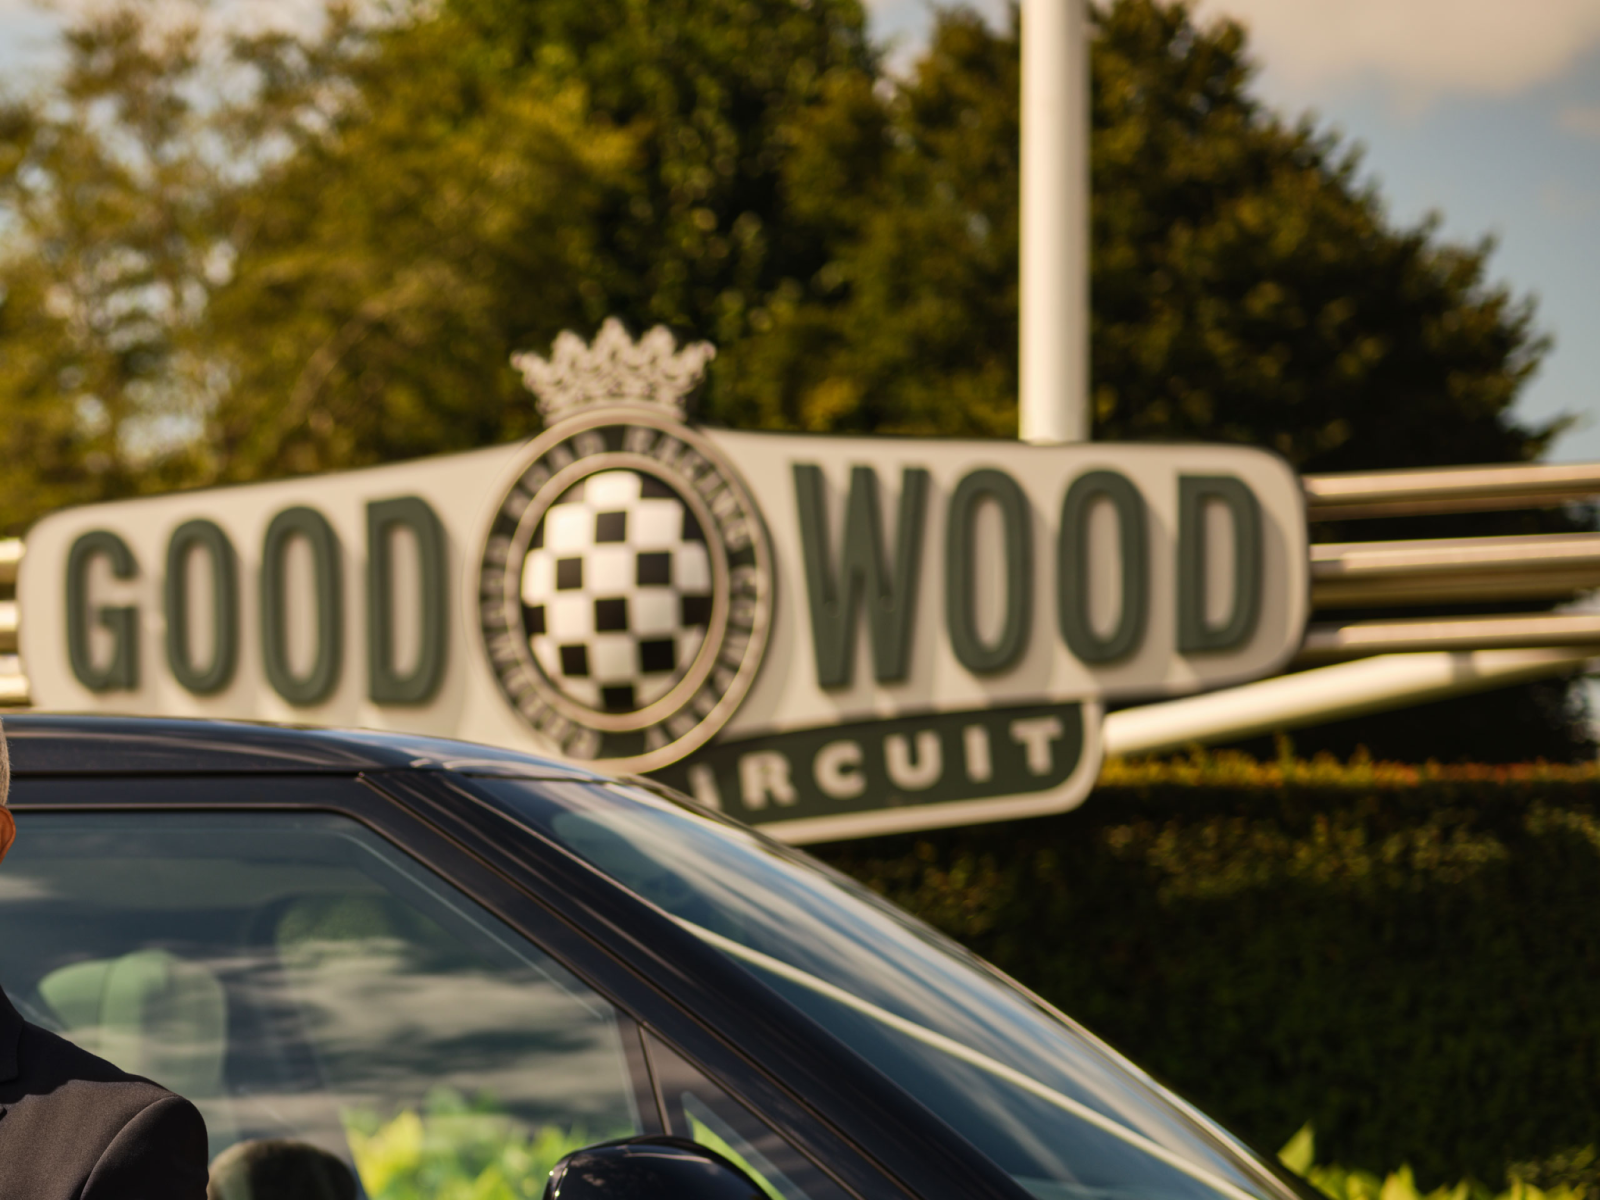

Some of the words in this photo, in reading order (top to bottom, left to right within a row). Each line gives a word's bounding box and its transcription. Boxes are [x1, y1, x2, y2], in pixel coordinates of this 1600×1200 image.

[65, 496, 450, 708] GOOD
[793, 461, 1266, 692] WOOD
[687, 714, 1064, 812] IRCUIT
